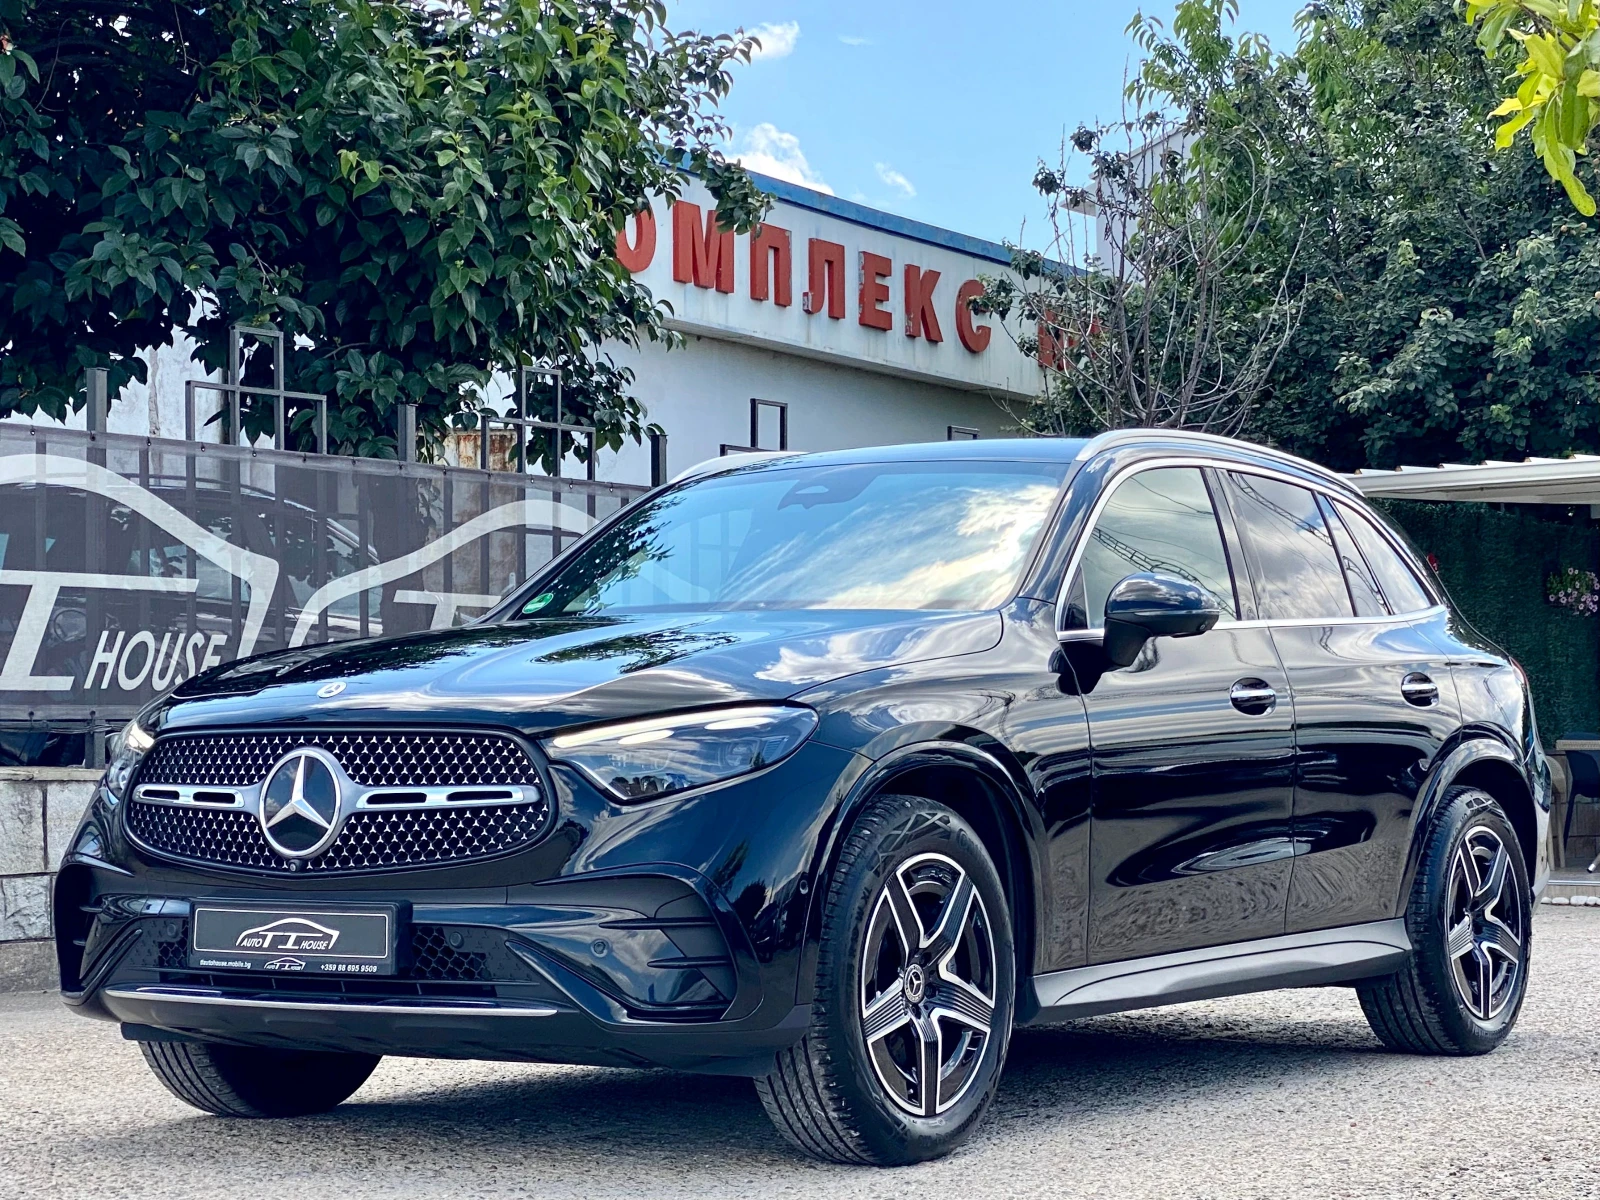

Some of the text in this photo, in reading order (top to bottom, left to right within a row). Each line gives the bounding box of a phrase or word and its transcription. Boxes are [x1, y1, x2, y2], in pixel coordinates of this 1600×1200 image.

[615, 199, 992, 355] ОМПЛЕКС
[83, 630, 228, 691] HOUSE
[241, 938, 263, 947] AUTO
[300, 940, 329, 950] HOUSE
[320, 963, 337, 971] +359
[346, 964, 360, 972] 695
